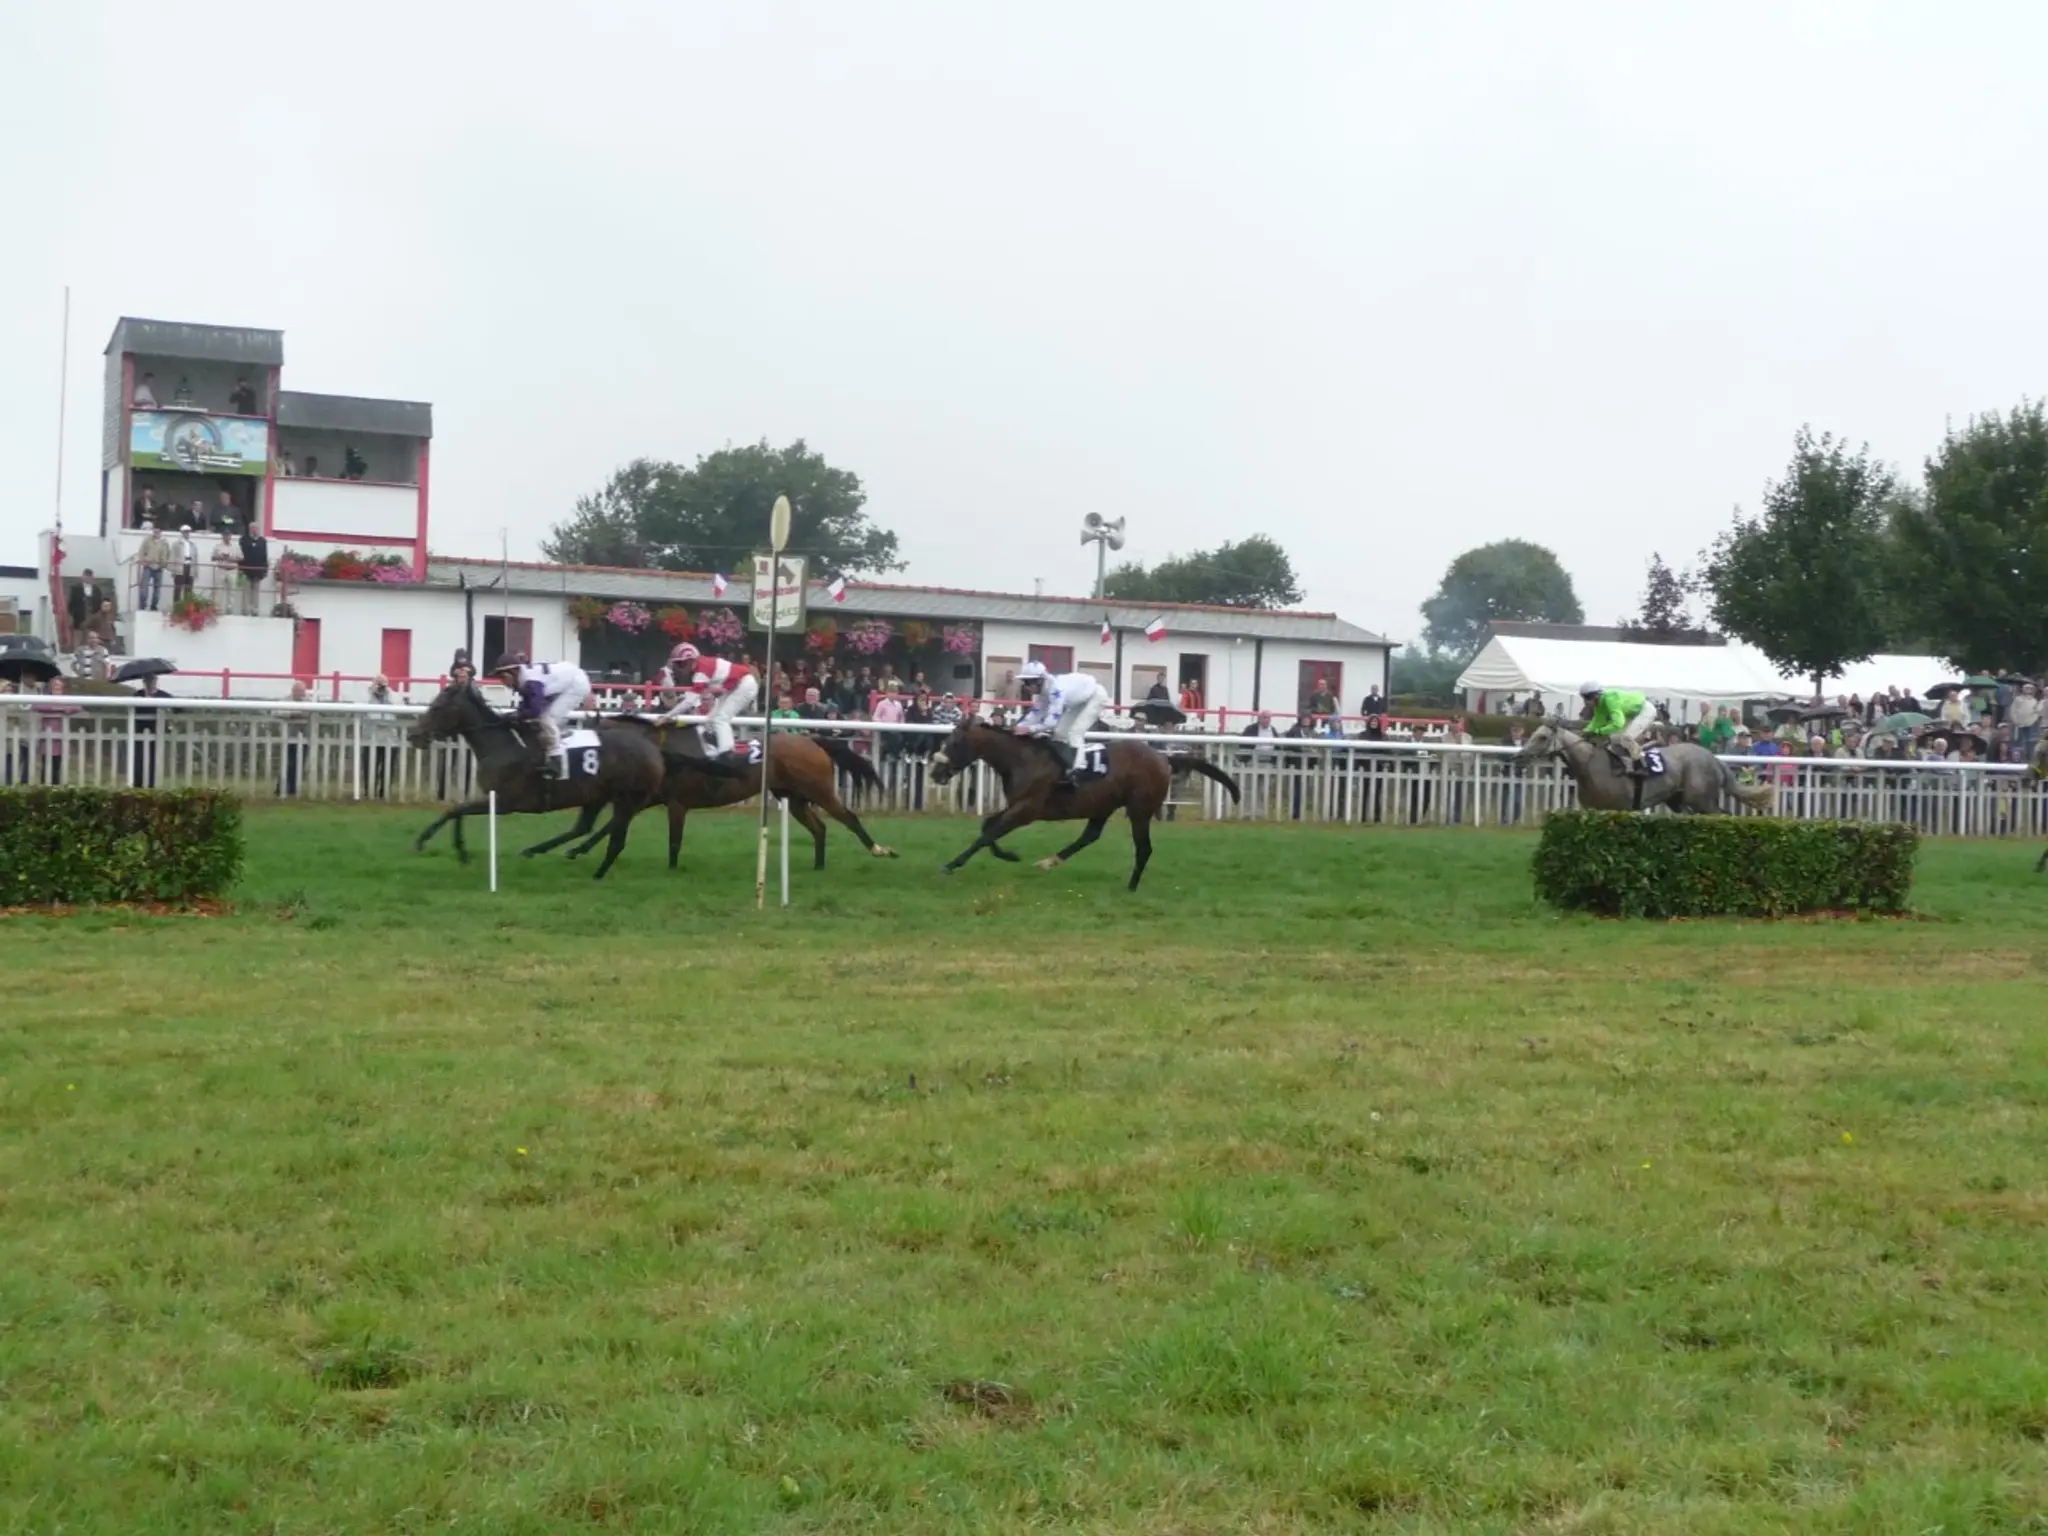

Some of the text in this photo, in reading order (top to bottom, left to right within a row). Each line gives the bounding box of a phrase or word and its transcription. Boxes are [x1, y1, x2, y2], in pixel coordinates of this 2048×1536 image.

[583, 749, 600, 776] 8
[748, 744, 764, 764] 2
[1648, 753, 1664, 773] 3
